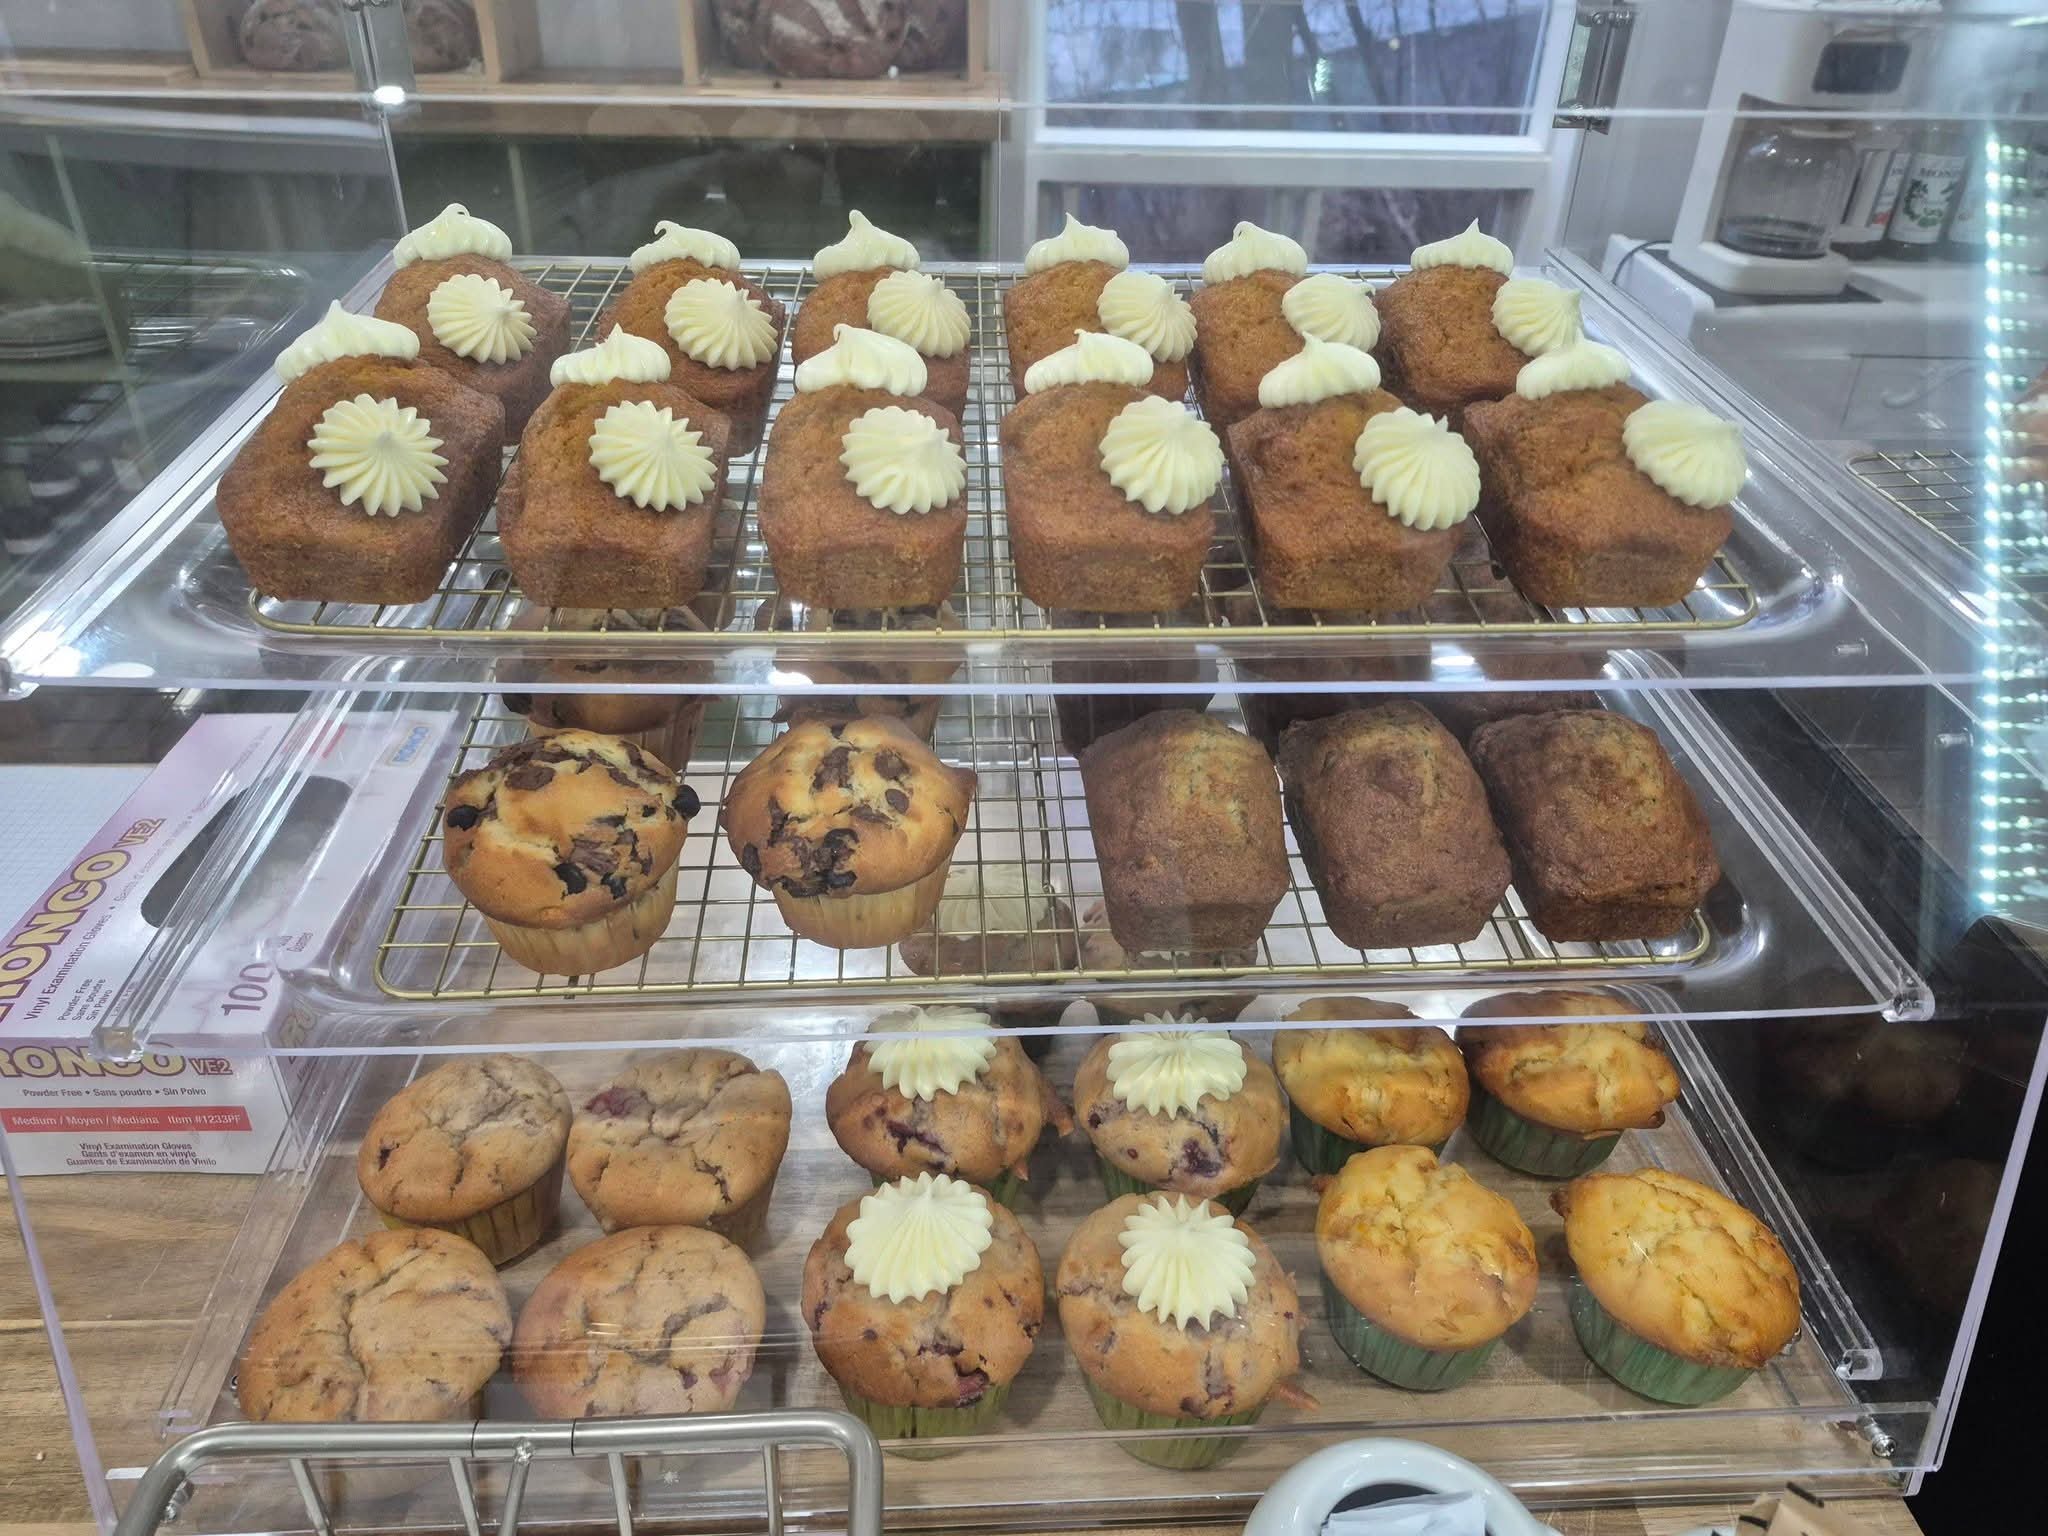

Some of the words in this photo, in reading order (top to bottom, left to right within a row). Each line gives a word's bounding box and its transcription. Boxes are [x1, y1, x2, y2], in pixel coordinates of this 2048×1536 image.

[112, 818, 167, 848] VE2
[24, 990, 52, 1021] Vinyl
[43, 940, 90, 995] Examination
[83, 914, 113, 942] Gloves
[58, 990, 79, 1021] Powder
[76, 978, 93, 995] Free
[72, 1000, 89, 1021] Sans
[87, 979, 106, 1002] poudre
[221, 962, 275, 1016] 100
[86, 1005, 100, 1021] Sin
[98, 989, 113, 1009] Polvo
[188, 1057, 234, 1076] VE2
[23, 1089, 59, 1097] Powder
[61, 1089, 82, 1097] Free
[93, 1088, 117, 1096] Sans
[120, 1088, 153, 1098] poudre
[162, 1087, 179, 1096] Sin
[181, 1087, 207, 1096] Polvo
[12, 1115, 57, 1126] Medium
[64, 1115, 104, 1127] Moyen
[111, 1115, 160, 1125] Mediana
[168, 1115, 192, 1124] Item
[195, 1113, 241, 1125] #1233PF
[79, 1142, 102, 1152] Vinyl
[104, 1142, 160, 1151] Examination
[161, 1142, 192, 1151] Gloves
[110, 1150, 155, 1158] d'examen
[169, 1150, 197, 1160] vinyle
[66, 1158, 105, 1167] Guantes
[106, 1158, 118, 1166] de
[178, 1158, 191, 1166] de
[191, 1158, 217, 1166] Vinilo
